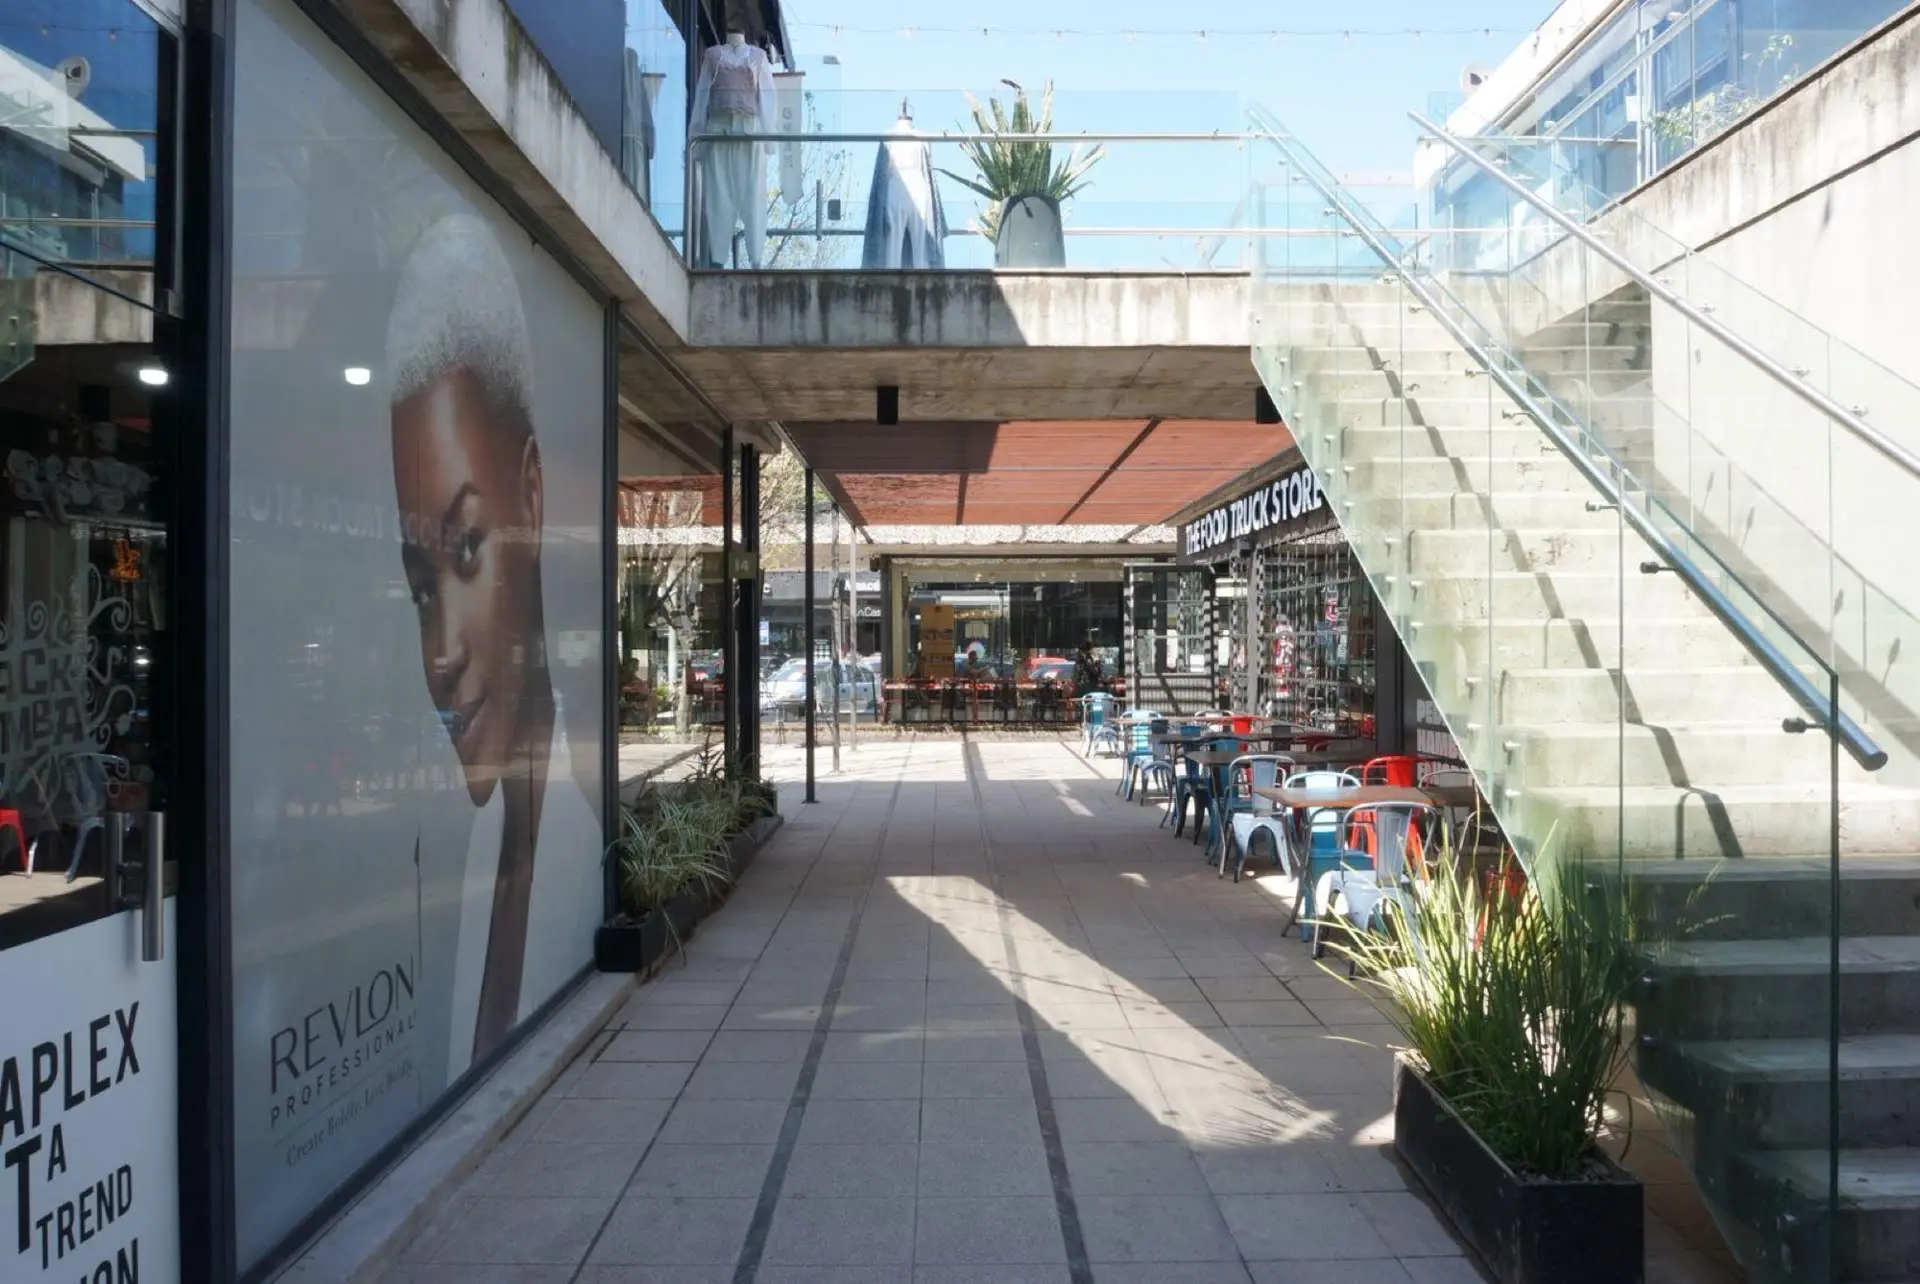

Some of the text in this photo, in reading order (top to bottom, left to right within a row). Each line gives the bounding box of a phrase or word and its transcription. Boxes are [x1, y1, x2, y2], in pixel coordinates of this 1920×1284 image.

[1185, 468, 1322, 556] THE FOOD TRUCK STORE
[0, 1000, 140, 1146] APLEX
[271, 956, 414, 1095] REVLON
[35, 1163, 133, 1271] TREND
